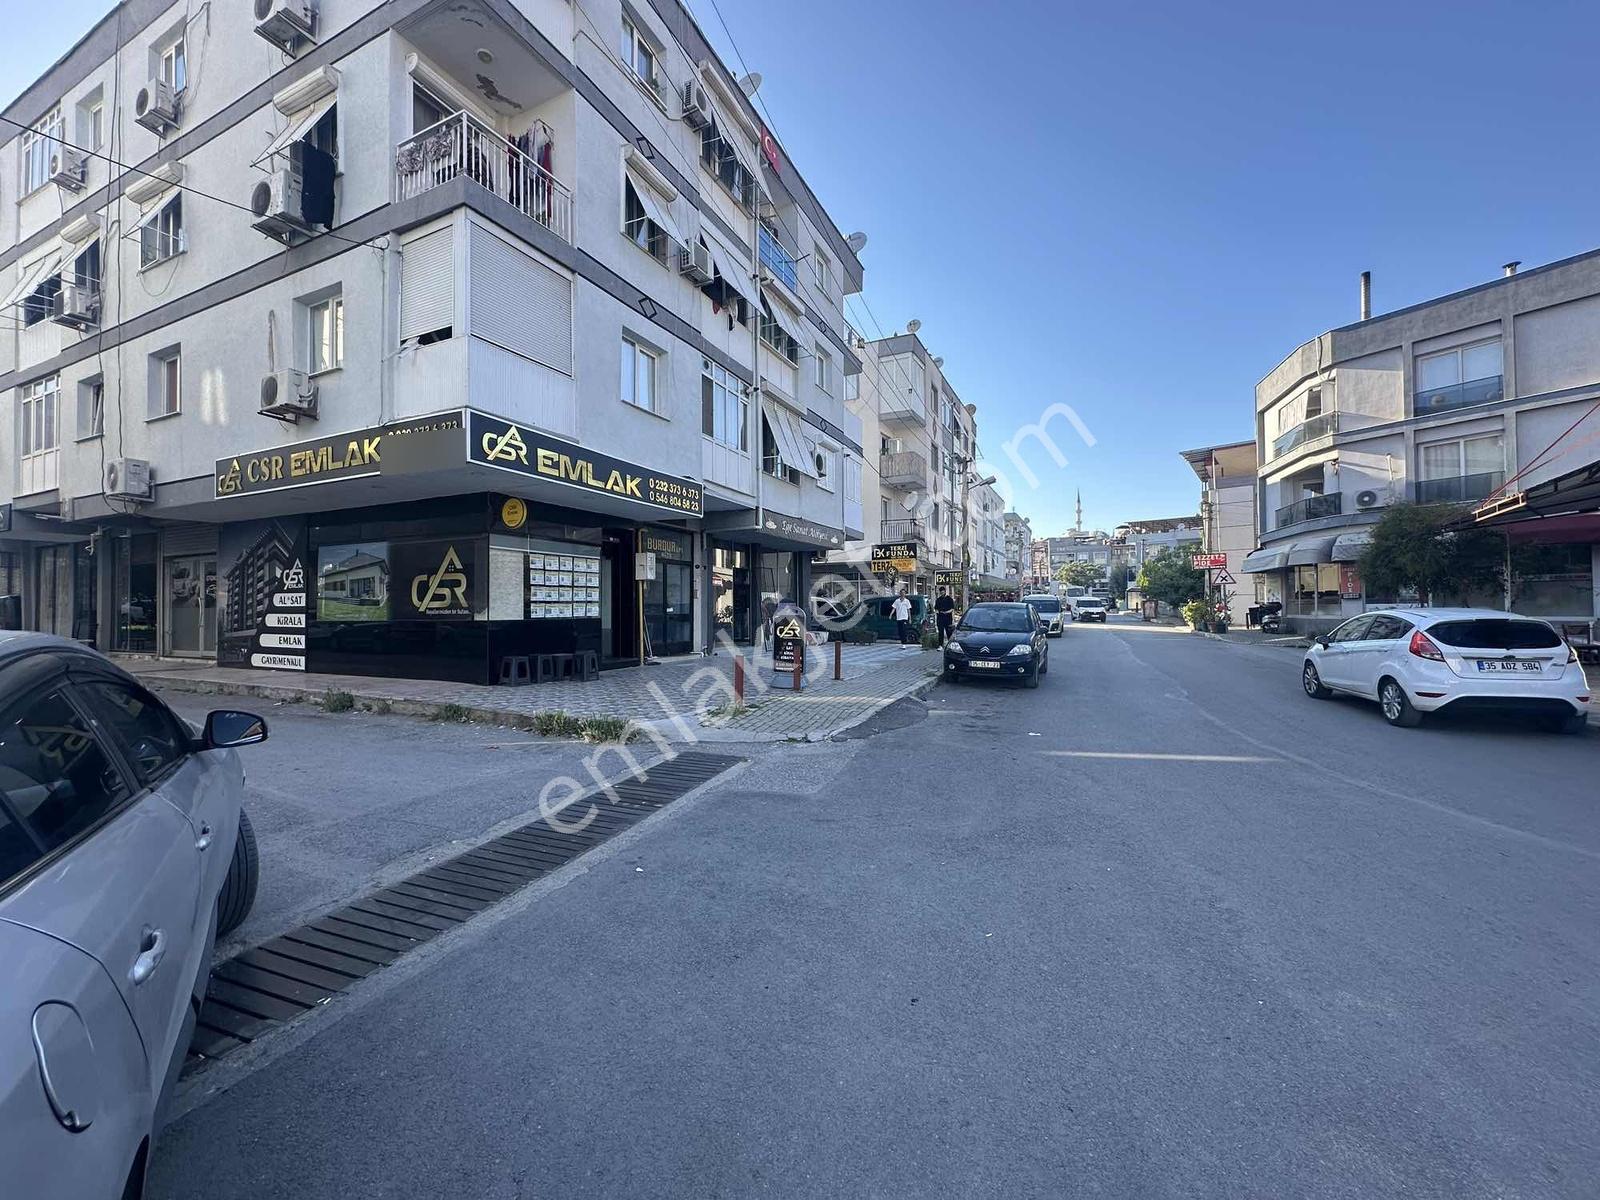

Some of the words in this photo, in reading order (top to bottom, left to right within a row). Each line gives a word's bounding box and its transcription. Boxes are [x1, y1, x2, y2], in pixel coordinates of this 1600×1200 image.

[247, 455, 284, 483] CSR
[290, 437, 381, 478] EMLAK
[537, 448, 643, 498] EMLAK
[649, 478, 655, 488] 0
[655, 480, 668, 492] 232
[669, 484, 681, 495] 373
[682, 488, 687, 497] 6
[687, 489, 699, 500] 373
[649, 491, 655, 501] 0
[655, 493, 668, 504] 546
[691, 501, 699, 511] 23
[278, 636, 303, 646] EMLAK
[1485, 662, 1497, 670] 35
[1522, 662, 1539, 671] 584
